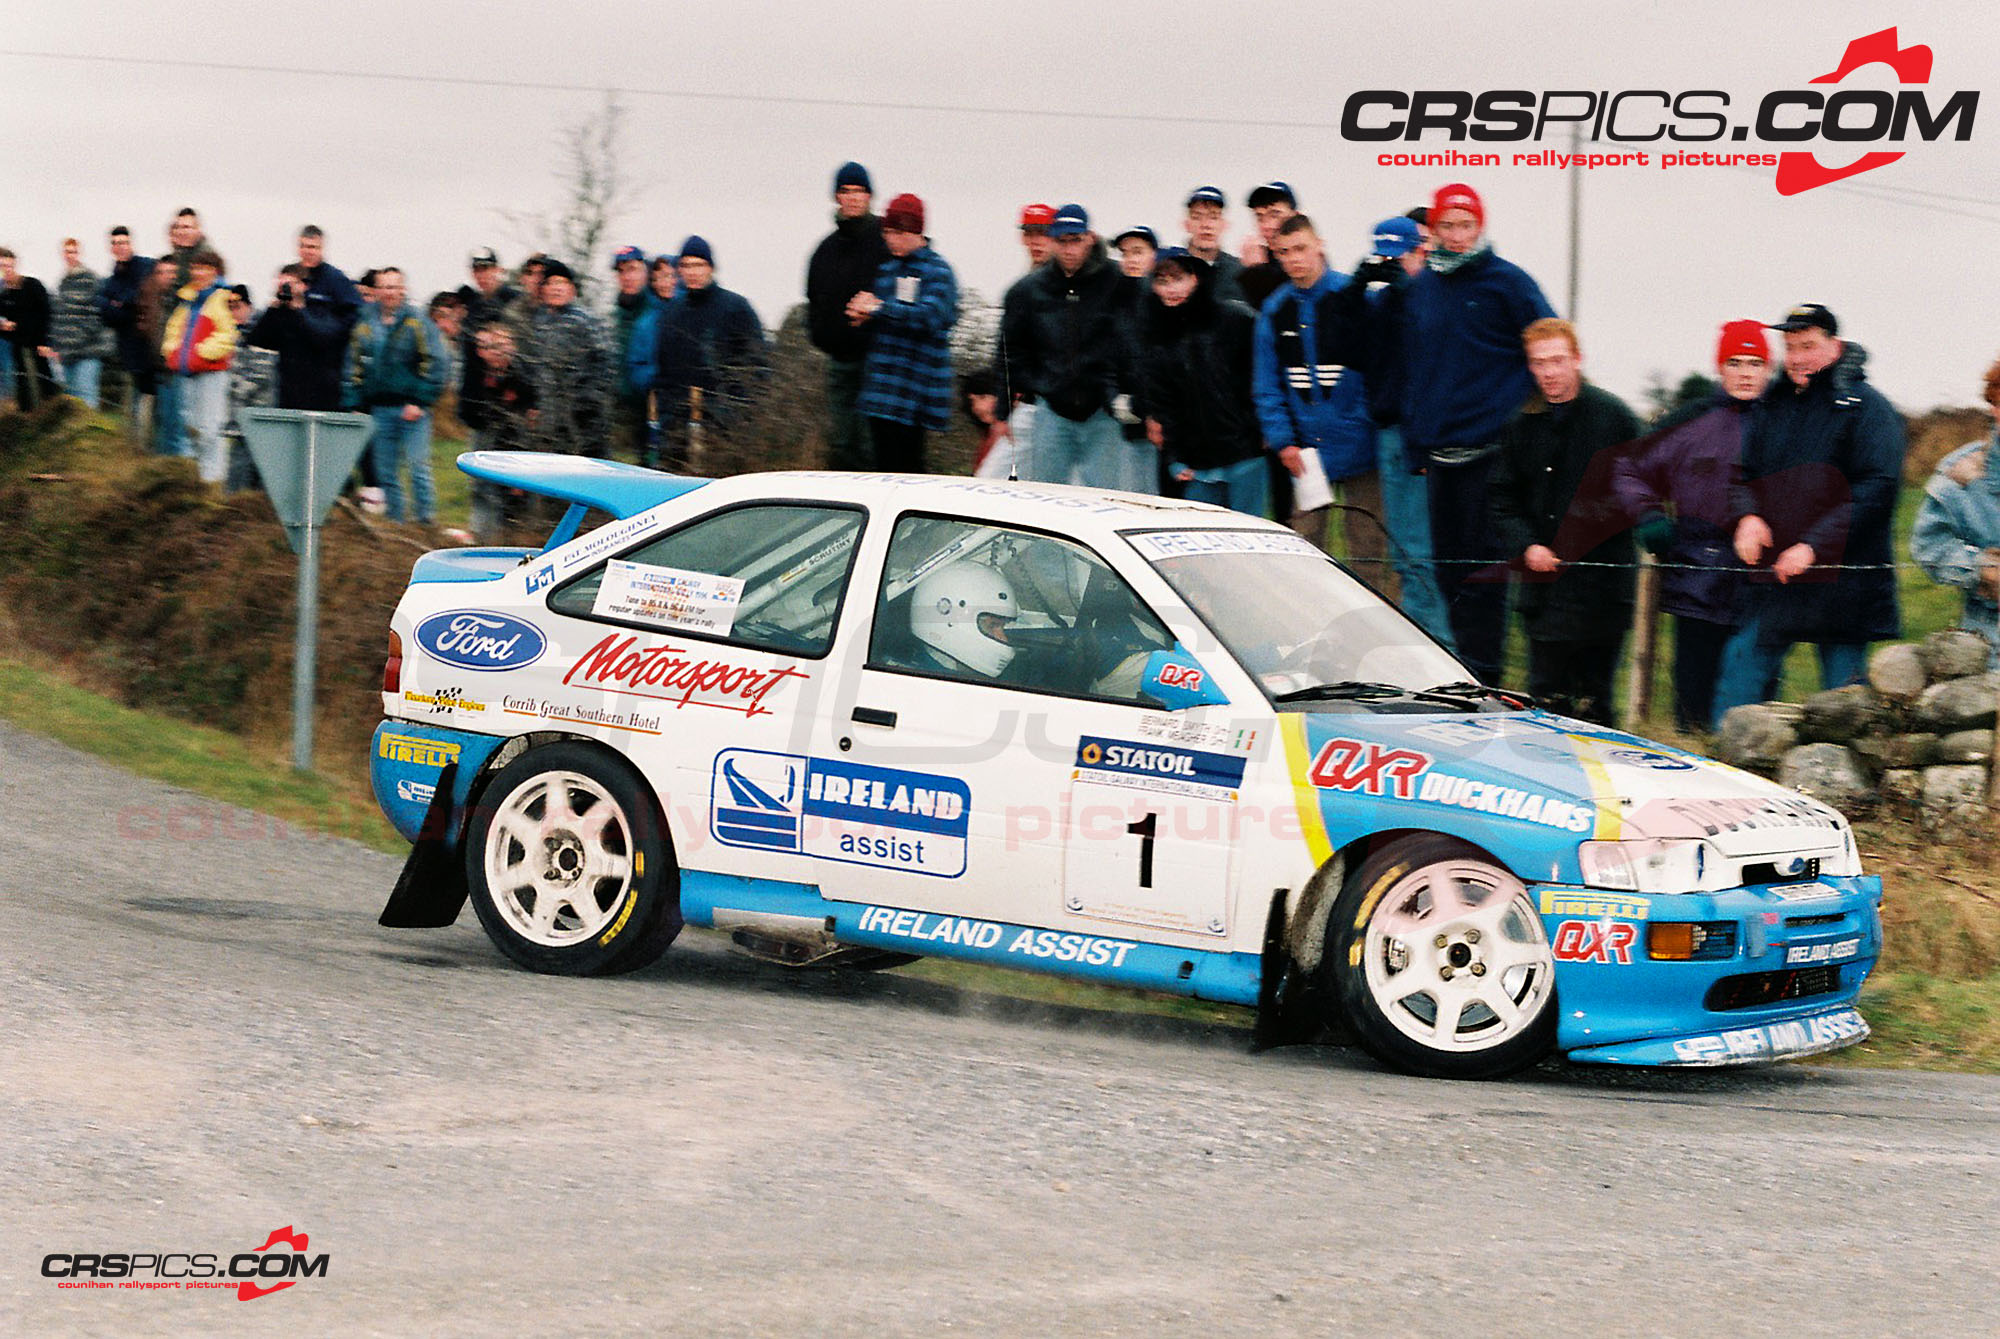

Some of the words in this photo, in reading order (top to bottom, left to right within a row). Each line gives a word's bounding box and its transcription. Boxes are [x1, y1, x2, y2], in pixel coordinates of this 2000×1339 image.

[435, 614, 514, 661] Ford
[562, 632, 810, 718] Motorsport
[1158, 662, 1204, 693] QXR
[503, 695, 538, 712] Corrib
[540, 701, 570, 718] Great
[575, 707, 624, 725] Southern
[629, 713, 660, 730] Hotel
[380, 732, 462, 767] PIRELLI
[1105, 746, 1196, 776] STATOIL
[1308, 737, 1434, 799] QXR
[809, 771, 963, 821] IRELAND
[1419, 773, 1595, 834] DUCKHAMS
[839, 824, 924, 864] assist
[1127, 812, 1157, 888] 1
[1540, 890, 1652, 919] PIRELLI
[859, 905, 1002, 949] IRELAND
[1009, 929, 1138, 968] ASSIST
[1552, 921, 1638, 965] QXR
